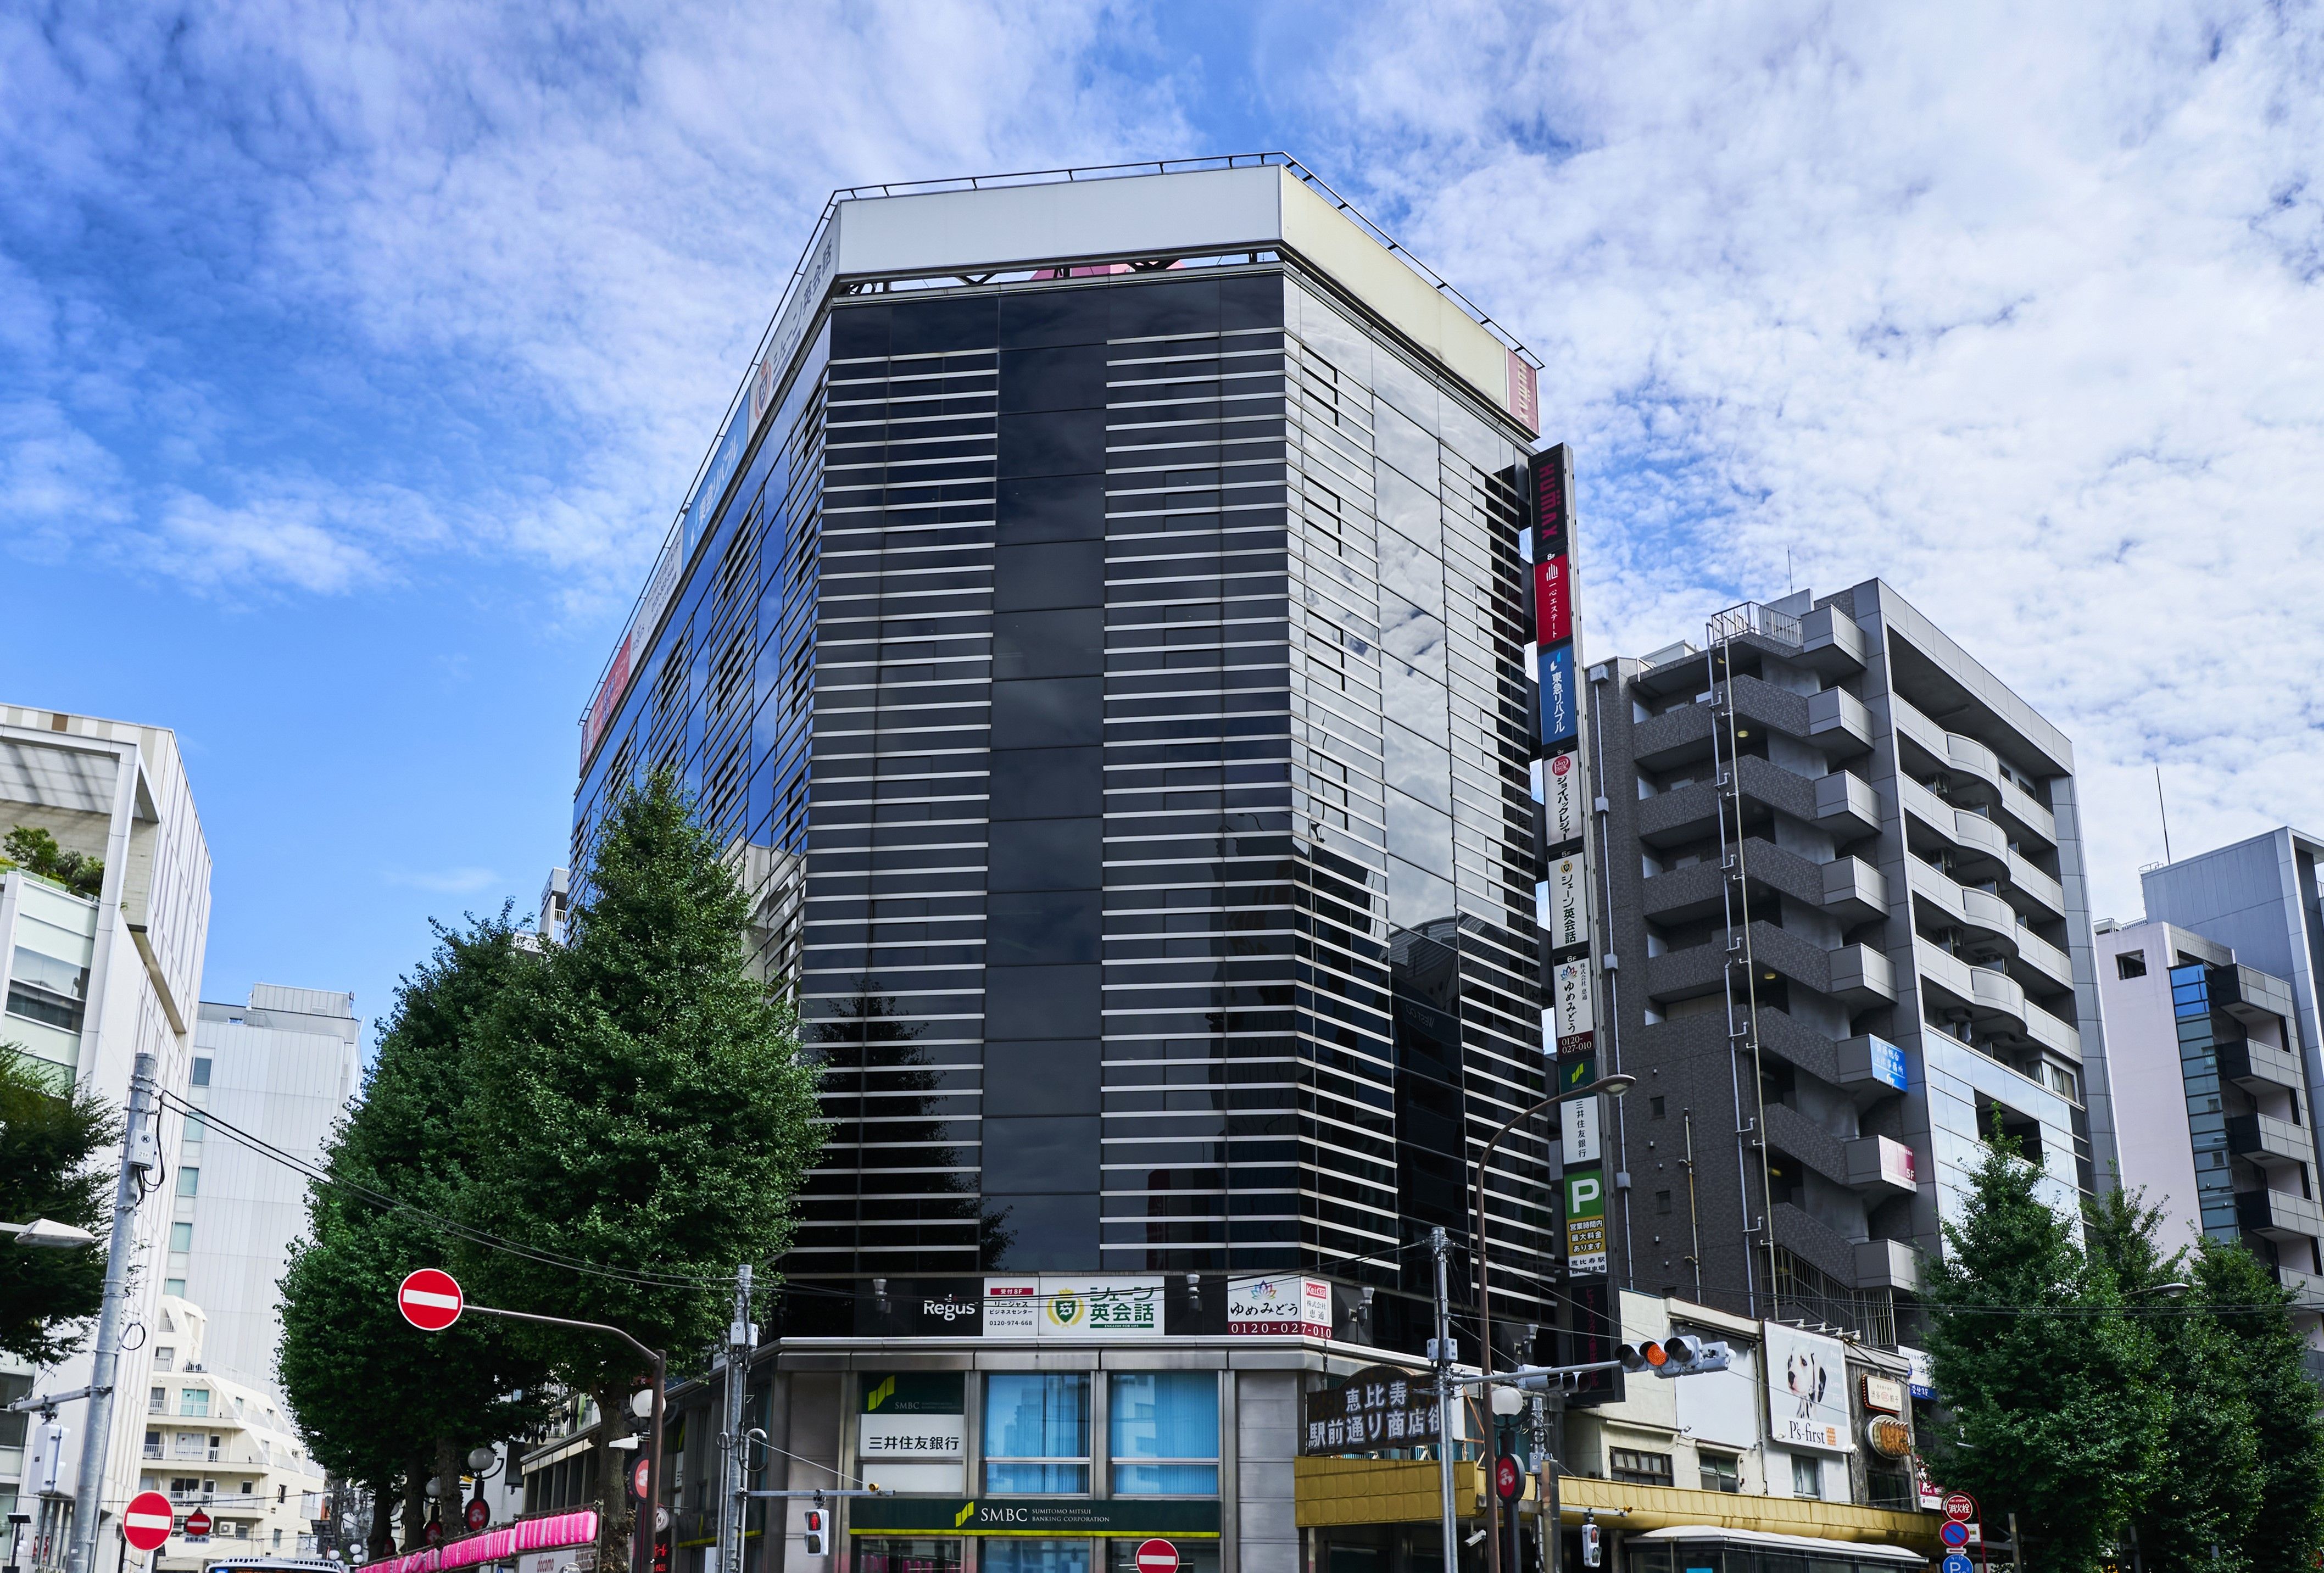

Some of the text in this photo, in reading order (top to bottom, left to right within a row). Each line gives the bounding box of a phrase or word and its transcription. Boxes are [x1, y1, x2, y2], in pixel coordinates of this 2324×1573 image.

[773, 238, 832, 375] シェーン英会話
[1539, 462, 1561, 540] HUMAX
[1549, 583, 1558, 638] 一心エステート
[1552, 671, 1565, 734] 東急リバブル
[1562, 874, 1576, 945] シェーン英会話
[1564, 981, 1577, 1033] ゆめみどう
[1562, 1035, 1583, 1046] 0120-
[1562, 1041, 1592, 1054] 027-010
[1576, 1101, 1586, 1158] 三井住友銀行
[1571, 1178, 1600, 1213] P
[1570, 1219, 1603, 1231] 営業時間内
[1571, 1231, 1602, 1242] 最大料金
[1573, 1242, 1602, 1252] あります
[1571, 1256, 1605, 1266] 恵比寿駅
[1090, 1287, 1154, 1301] シェーン
[1306, 1285, 1327, 1296] Keitsu
[924, 1300, 976, 1321] Regus
[1090, 1303, 1154, 1321] 英会話
[1230, 1302, 1298, 1316] ゆめみどう
[1307, 1300, 1327, 1310] 株式会社
[1231, 1323, 1331, 1338] 0120-027-010
[1346, 1380, 1407, 1413] 恵比寿
[869, 1436, 959, 1450] 三井住友銀行
[980, 1508, 1028, 1522] SMBC
[1948, 1503, 1970, 1514] 消火栓
[537, 1558, 554, 1573] docomo
